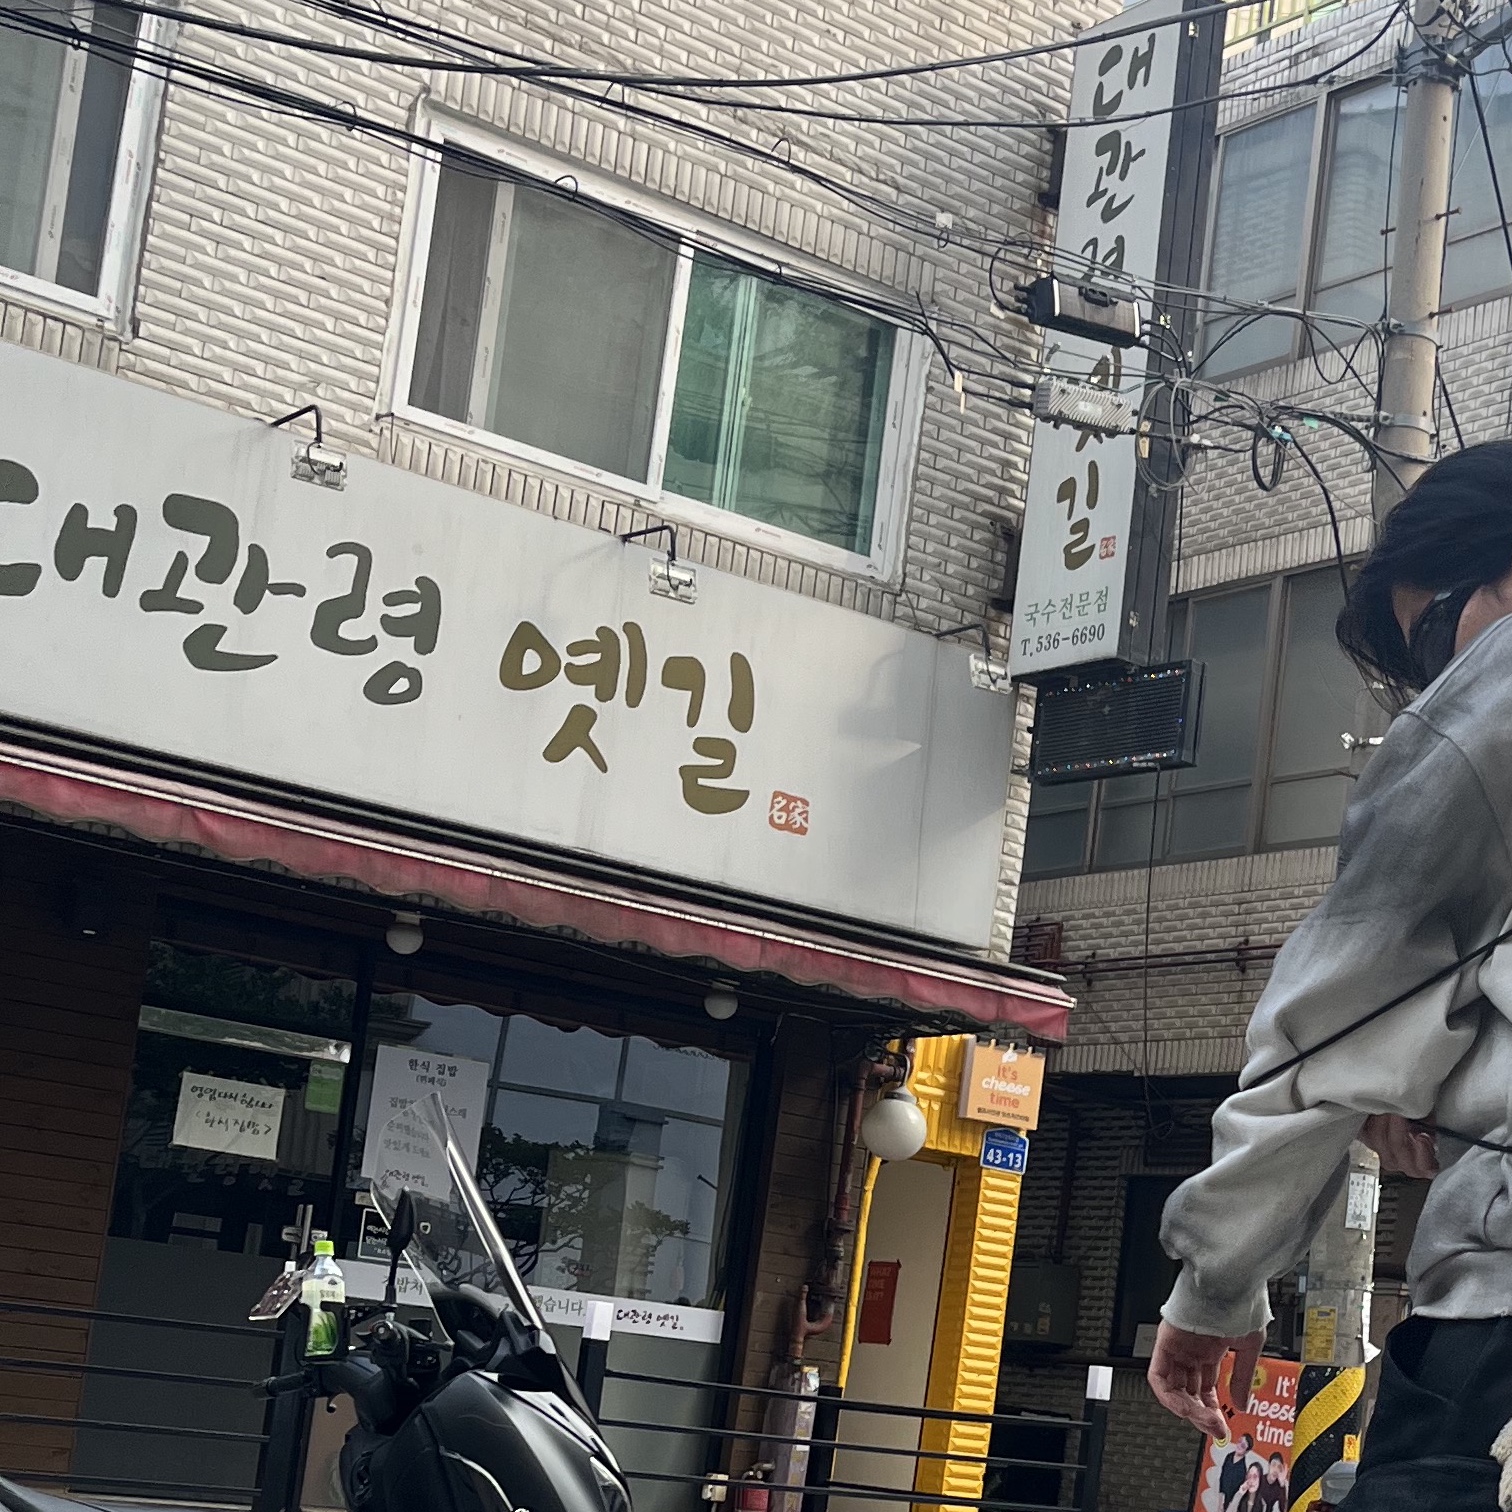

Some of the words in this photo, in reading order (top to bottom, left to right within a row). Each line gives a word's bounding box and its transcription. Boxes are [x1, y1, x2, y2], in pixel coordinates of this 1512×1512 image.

[1024, 586, 1110, 628] 국수전문점
[0, 458, 442, 706] 대관령
[497, 620, 757, 816] 옛길
[1021, 622, 1106, 658] T.536-6690
[408, 1058, 431, 1073] 한식
[996, 1064, 1019, 1081] It's
[981, 1075, 1032, 1097] cheese
[989, 1091, 1020, 1109] time
[985, 1147, 1023, 1169] 43-13
[616, 1308, 653, 1325] 대관령
[1245, 1393, 1297, 1423] heese
[1256, 1420, 1295, 1447] time
